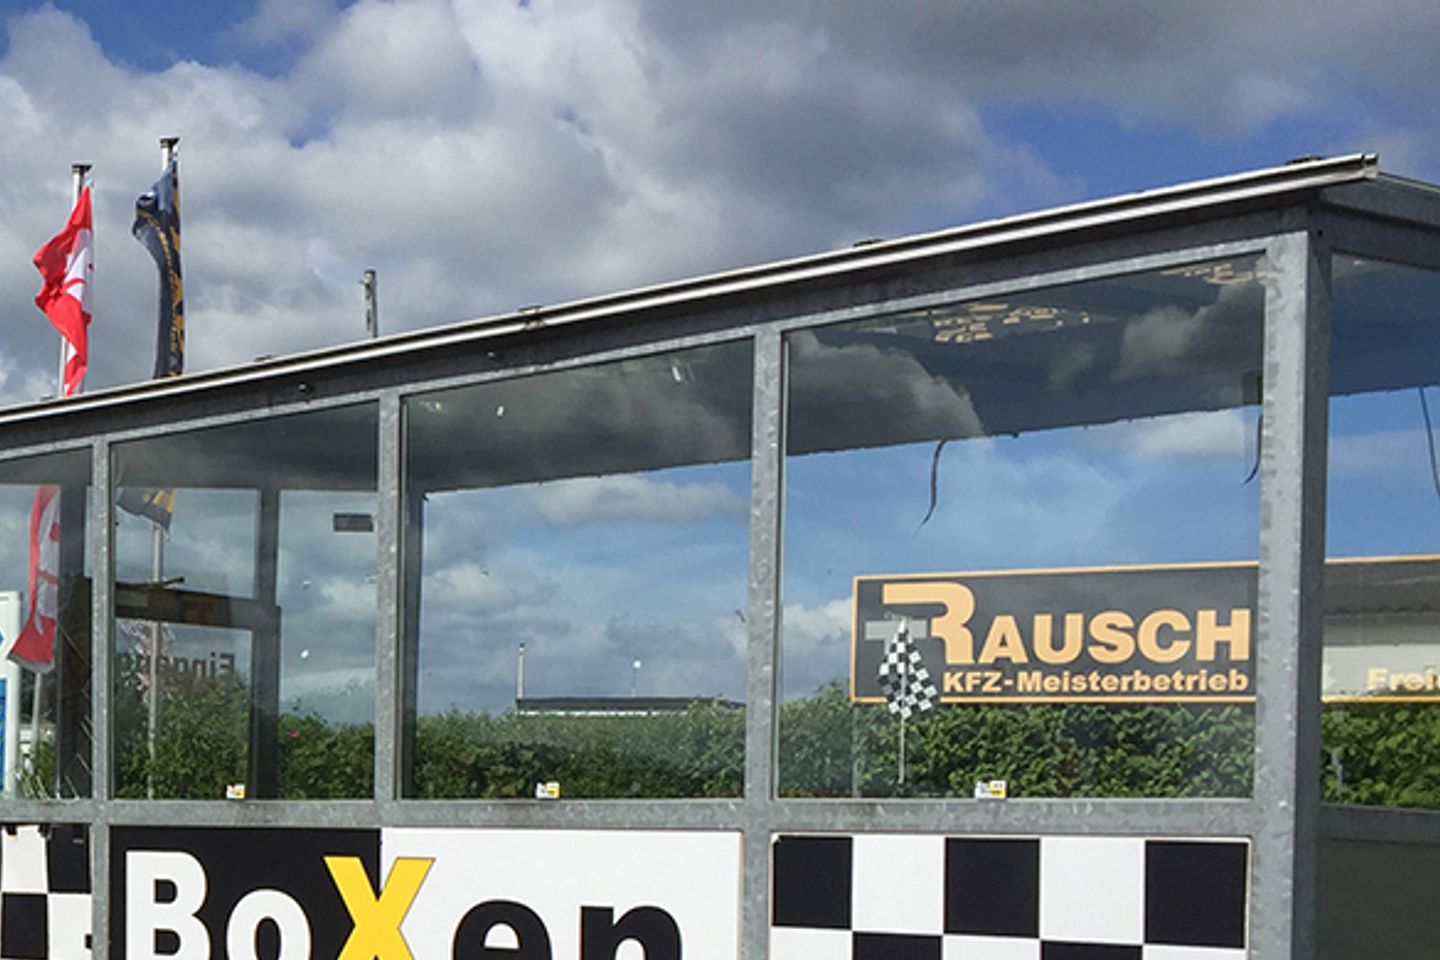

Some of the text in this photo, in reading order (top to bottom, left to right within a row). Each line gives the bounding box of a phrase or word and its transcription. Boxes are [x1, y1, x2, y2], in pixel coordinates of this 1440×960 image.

[882, 582, 1250, 664] RAUSCH
[942, 669, 1249, 693] KFZ-Meisterbetrieb
[1367, 665, 1440, 691] Frei
